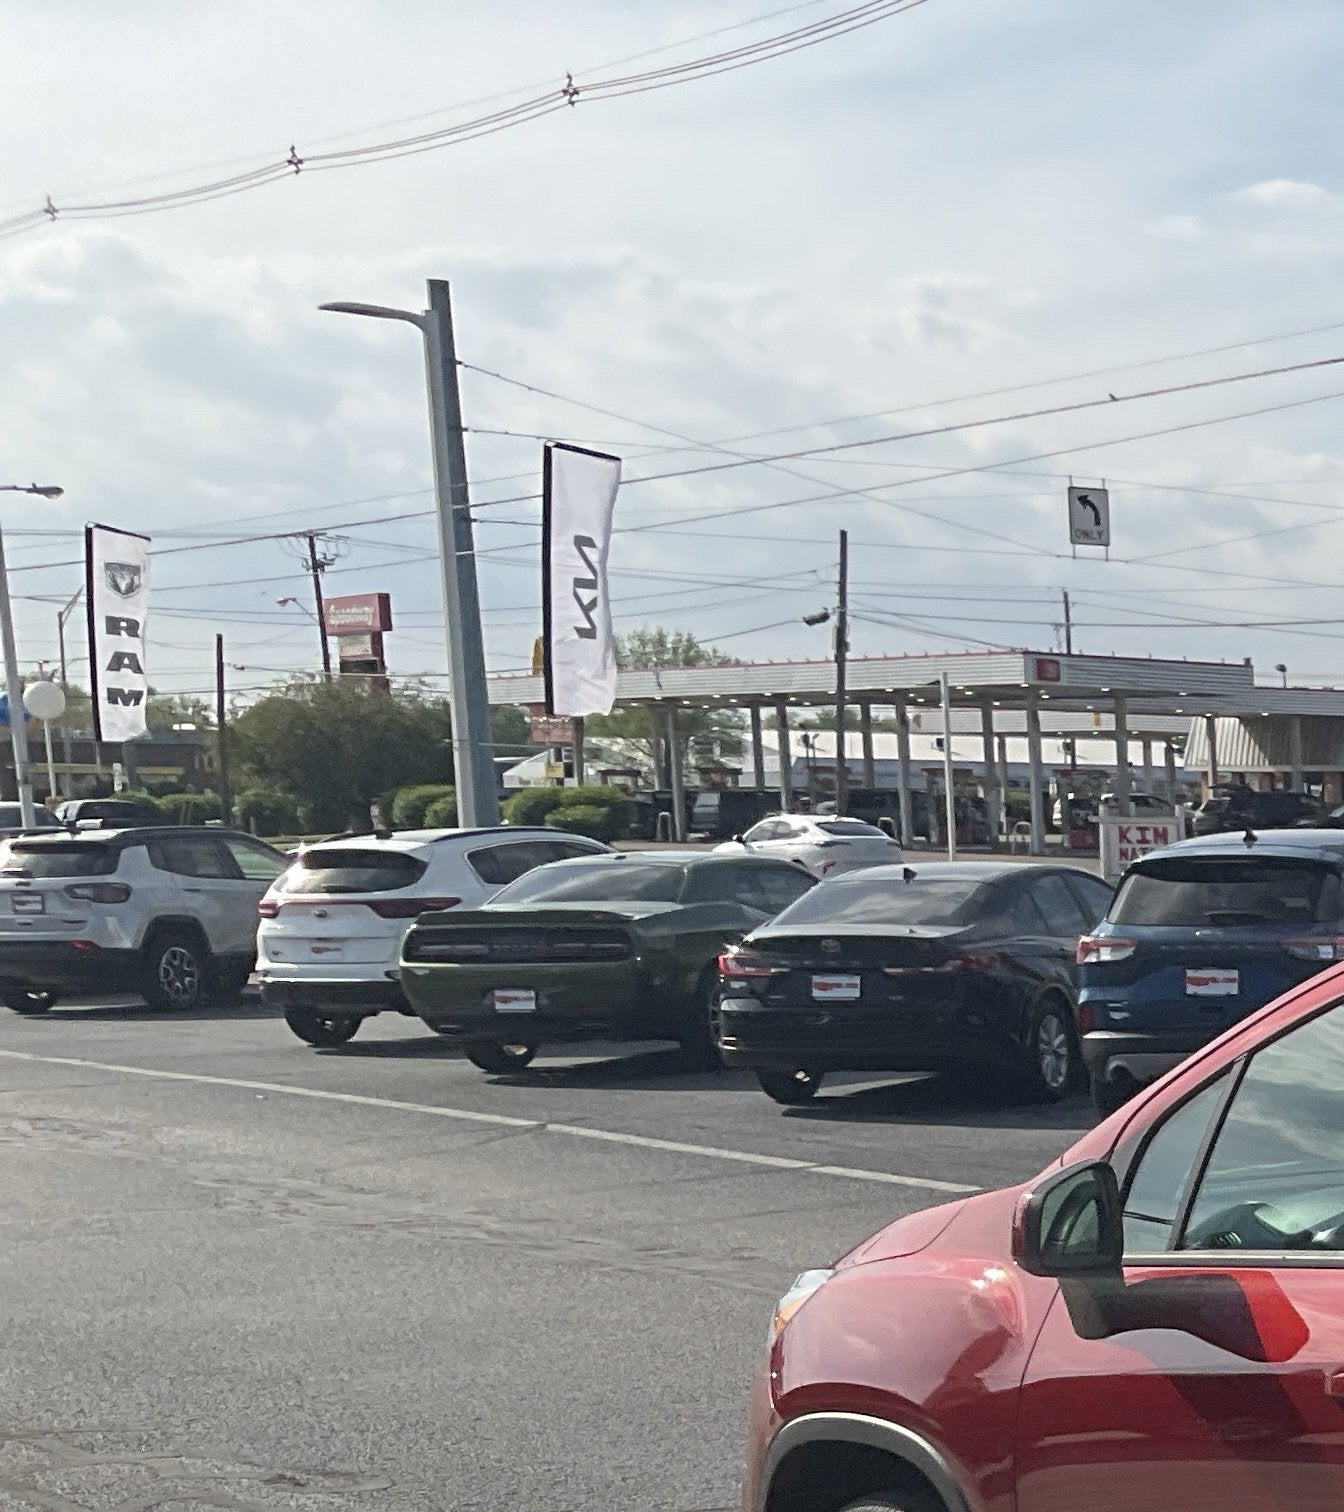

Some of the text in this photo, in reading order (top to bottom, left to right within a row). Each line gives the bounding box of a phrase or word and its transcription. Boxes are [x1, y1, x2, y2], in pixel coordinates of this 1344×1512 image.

[1075, 529, 1104, 541] ONLY
[105, 615, 144, 707] RAM
[1118, 826, 1168, 845] KIM
